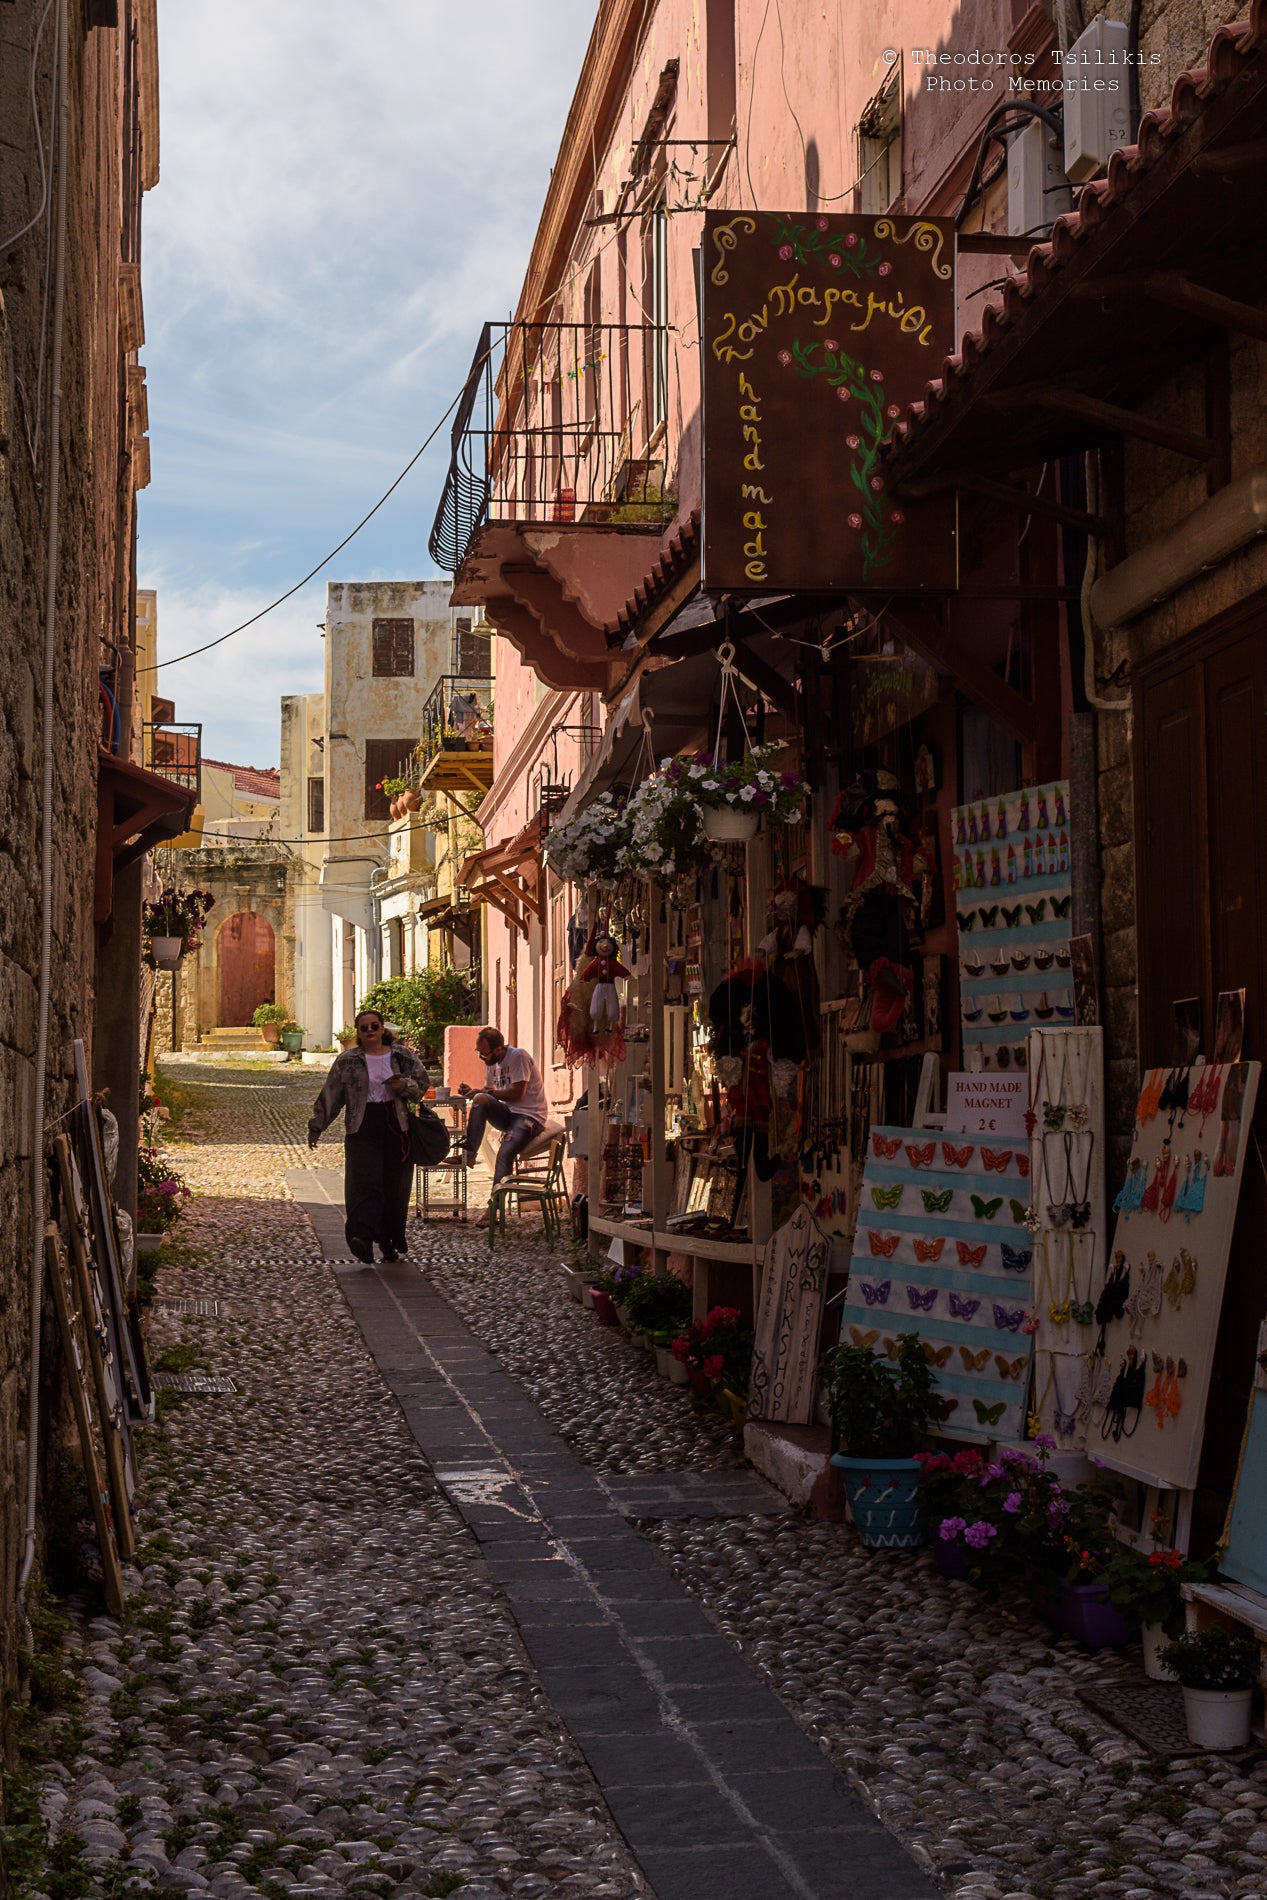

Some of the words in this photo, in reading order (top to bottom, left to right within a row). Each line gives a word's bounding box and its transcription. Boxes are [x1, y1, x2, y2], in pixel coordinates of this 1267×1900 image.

[1108, 128, 1128, 141] 52
[956, 1082, 987, 1093] HAND
[989, 1082, 1022, 1093] MADE
[964, 1098, 1013, 1109] MAGNET
[978, 1118, 986, 1131] 2
[989, 1119, 997, 1131] €
[772, 1246, 806, 1420] WORKSHOP
